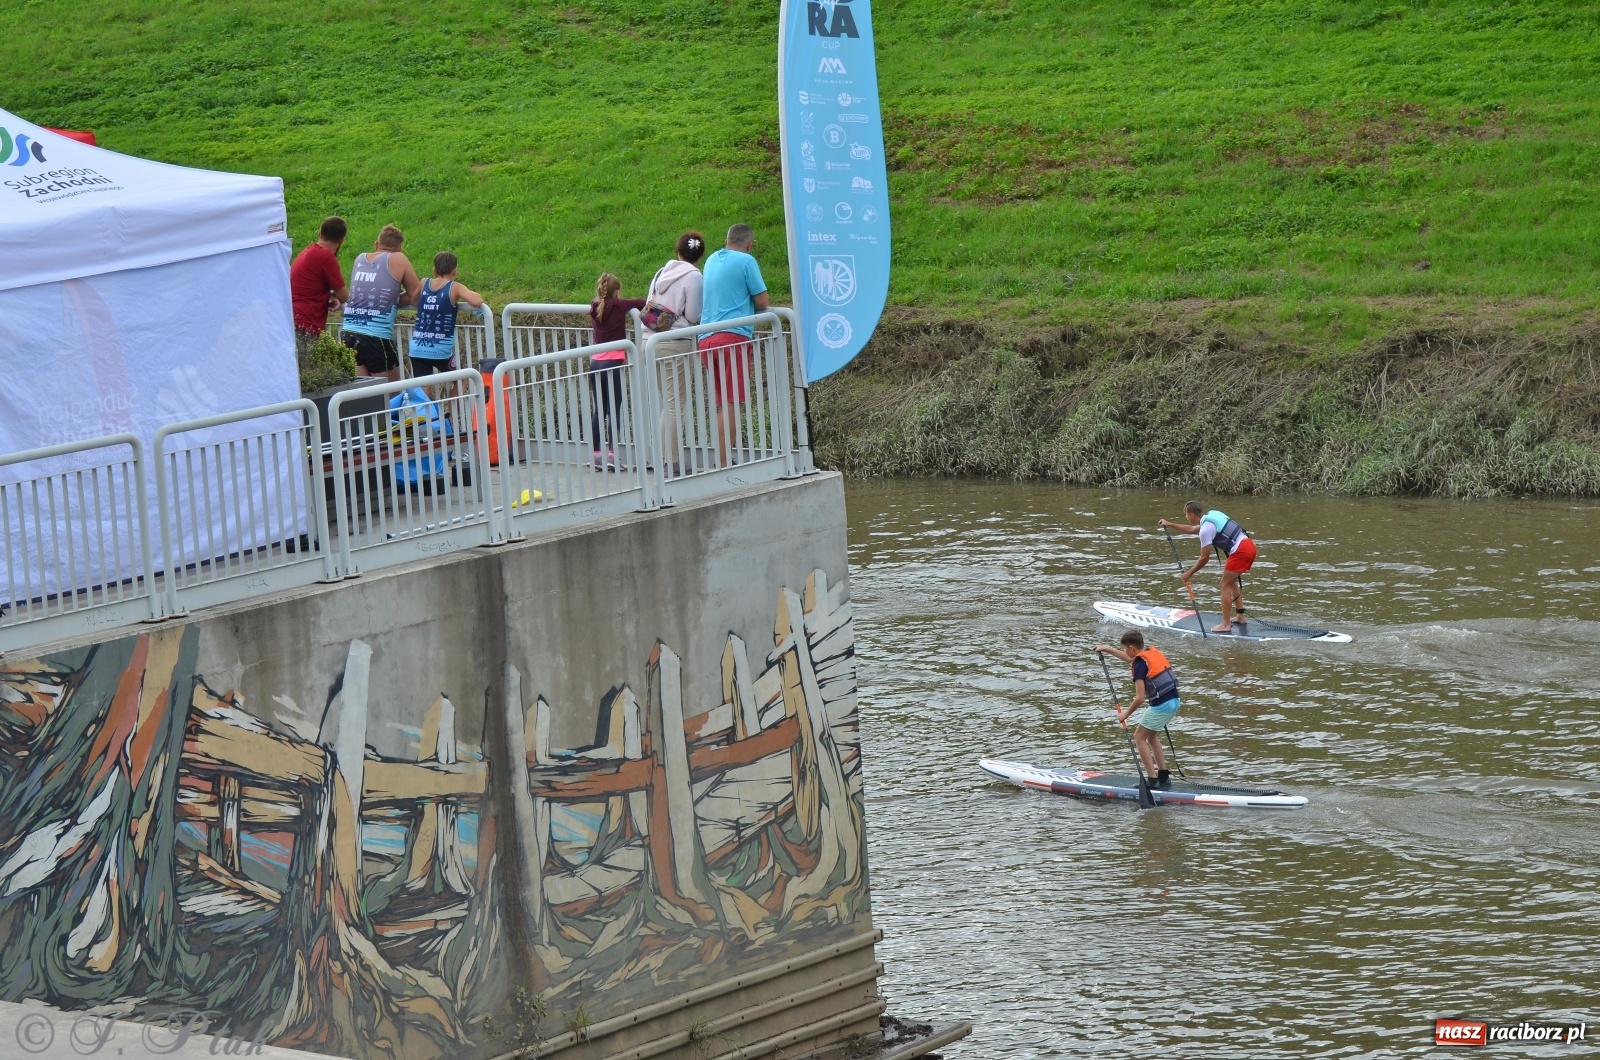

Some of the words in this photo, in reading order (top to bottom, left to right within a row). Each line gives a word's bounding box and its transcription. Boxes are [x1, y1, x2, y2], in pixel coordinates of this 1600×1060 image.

[822, 41, 843, 49] CUP
[4, 167, 98, 189] Subregion
[18, 175, 113, 198] Zachodni
[808, 231, 837, 242] intex
